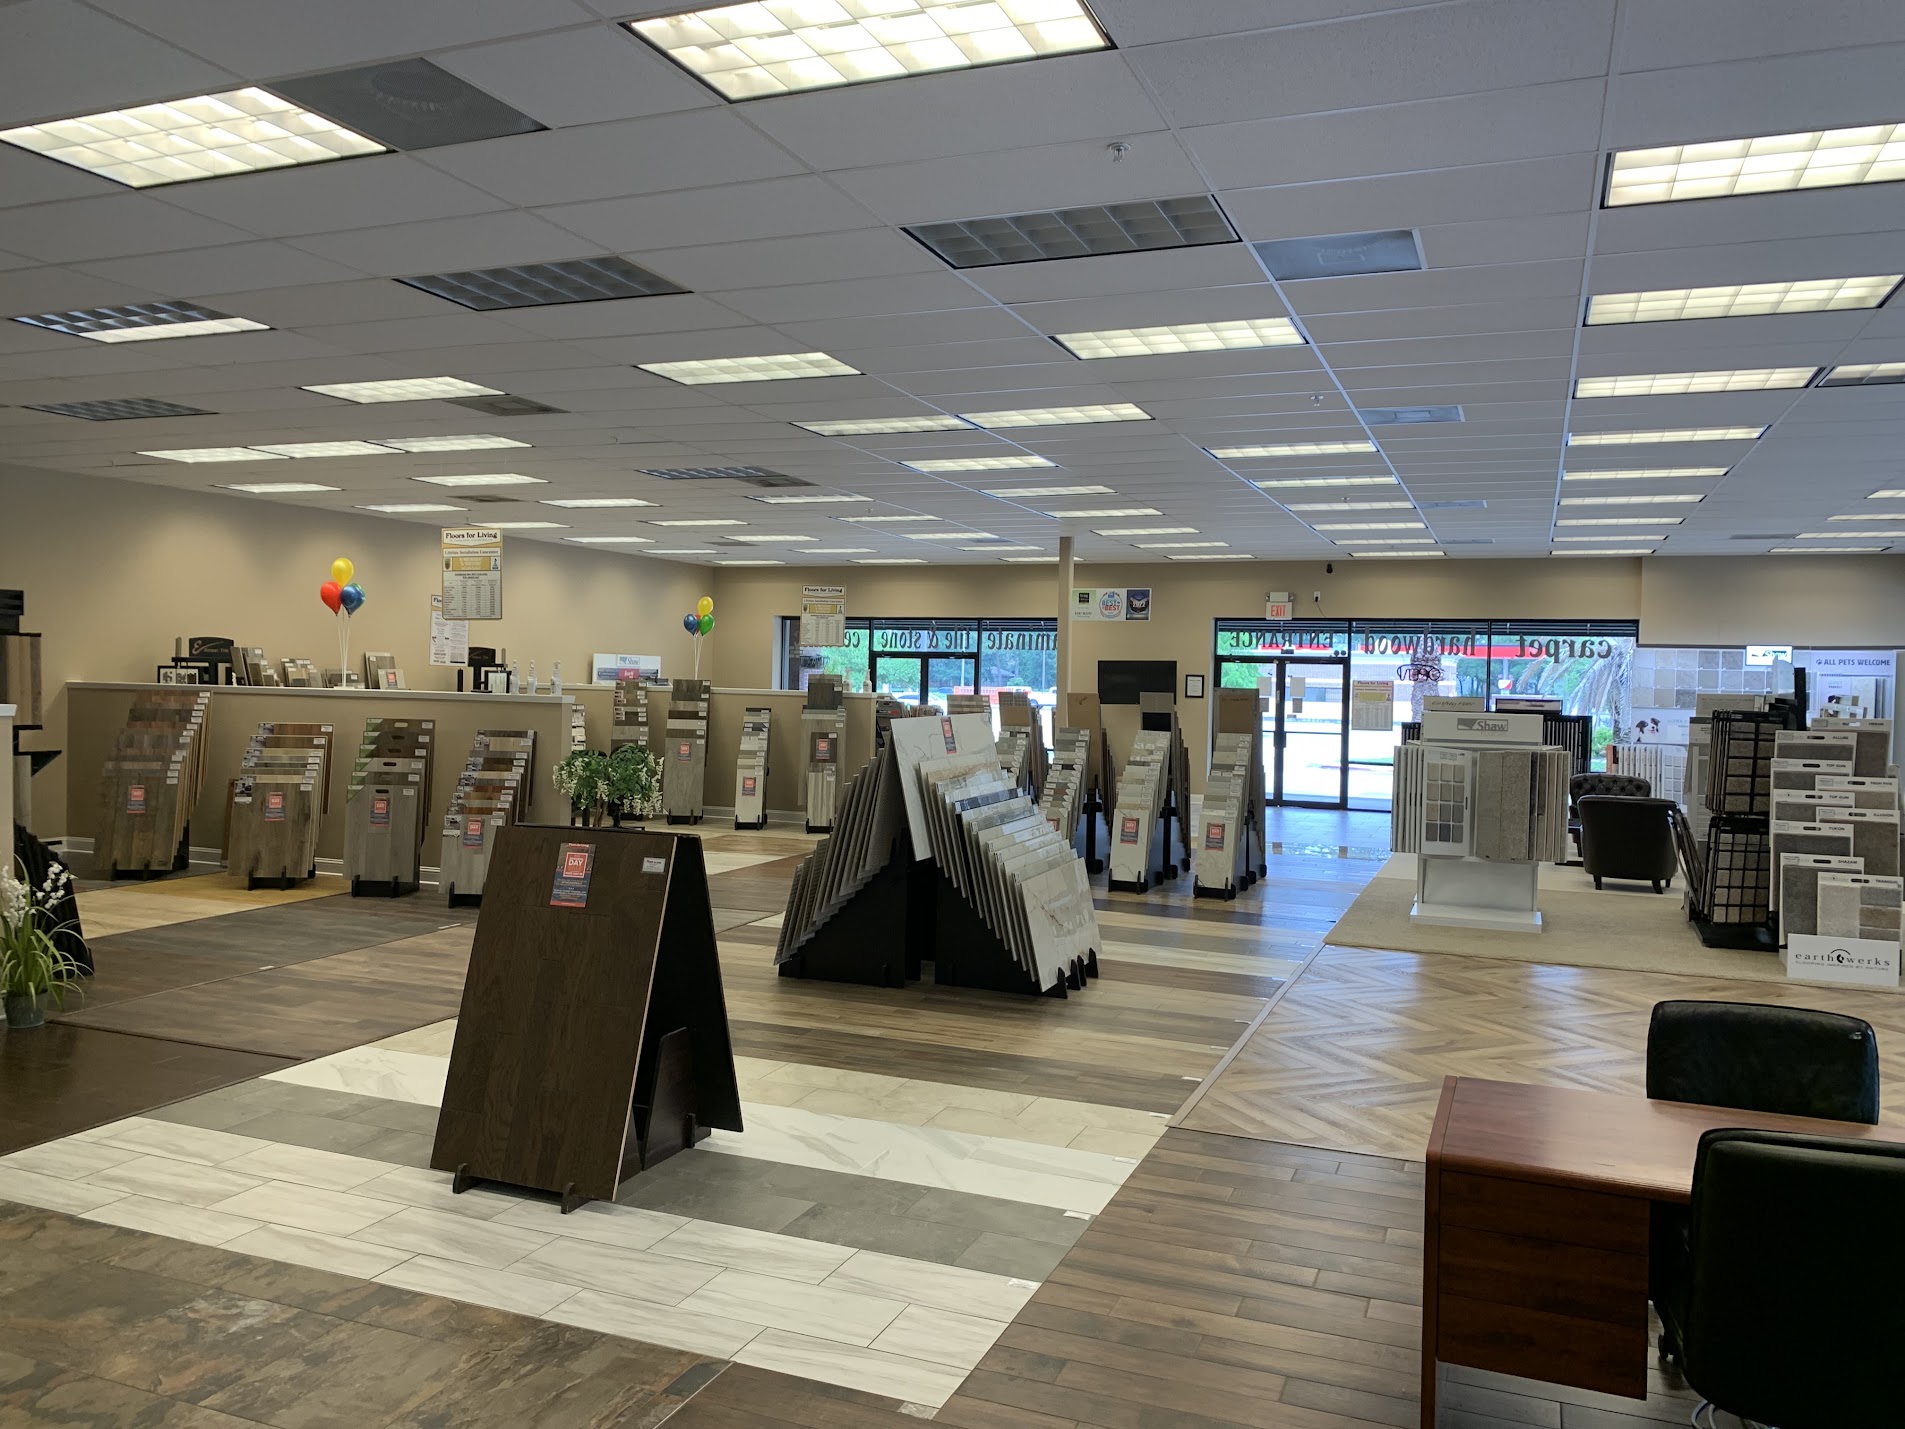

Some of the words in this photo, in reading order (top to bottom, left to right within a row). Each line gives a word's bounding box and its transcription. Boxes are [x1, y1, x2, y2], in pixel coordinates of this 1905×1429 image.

[477, 531, 498, 539] Living
[1270, 604, 1287, 617] EXIT
[1823, 658, 1836, 666] ALL
[1838, 658, 1856, 666] PETS
[1477, 720, 1507, 731] Shaw
[568, 859, 584, 867] DAY
